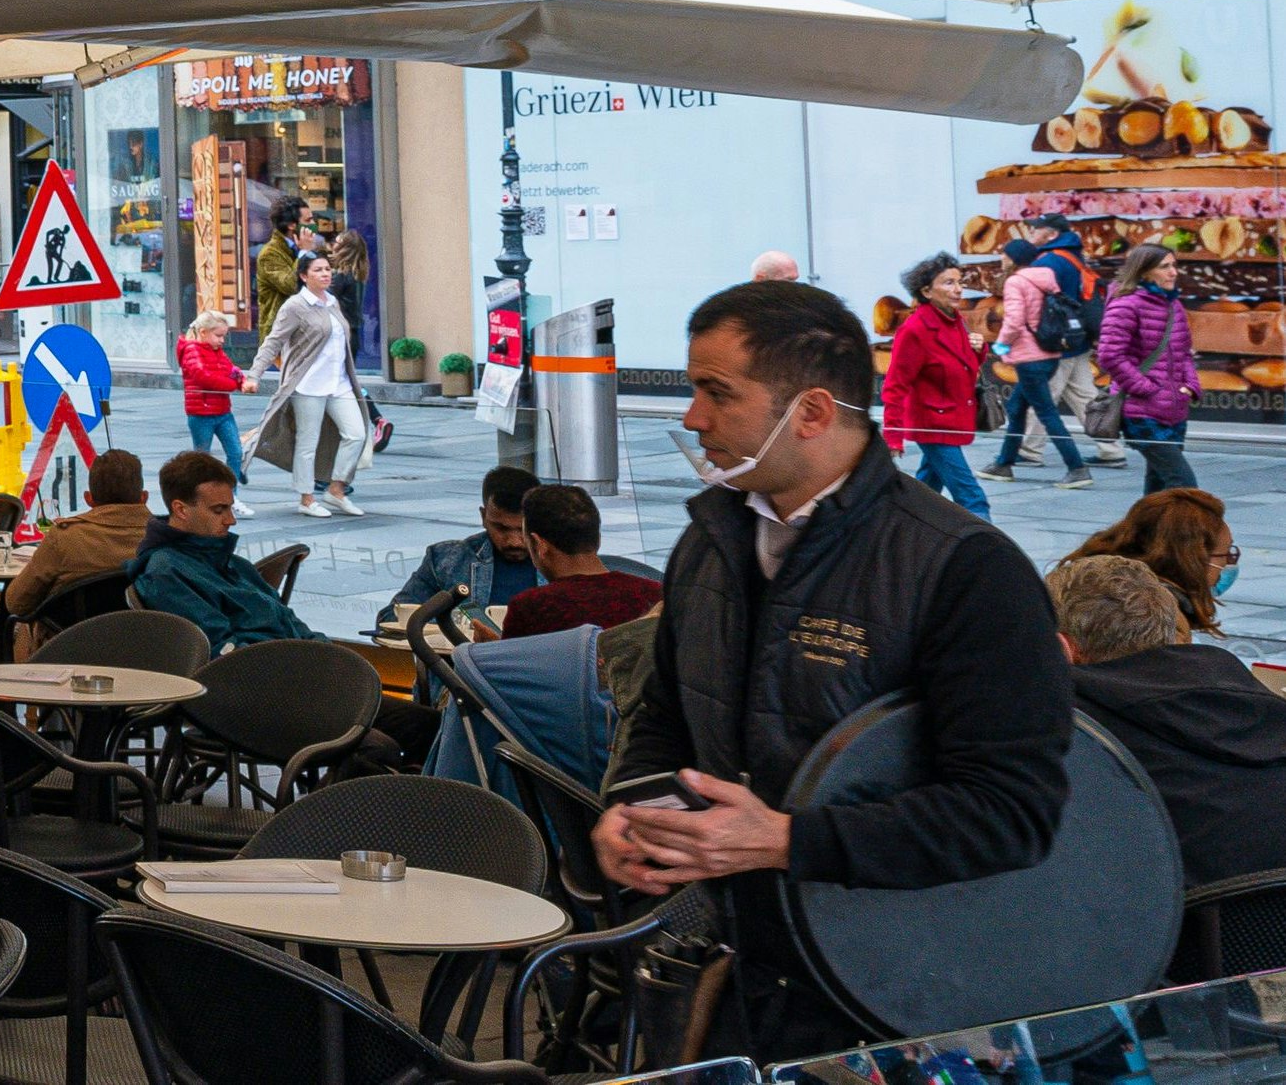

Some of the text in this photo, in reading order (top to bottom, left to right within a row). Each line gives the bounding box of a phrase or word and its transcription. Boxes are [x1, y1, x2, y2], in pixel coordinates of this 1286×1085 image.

[190, 66, 354, 95] SPOIL ME, HONEY
[515, 83, 613, 116] Grüezi
[520, 161, 588, 173] aderach.com
[523, 185, 542, 197] etzt
[840, 623, 867, 640] DE
